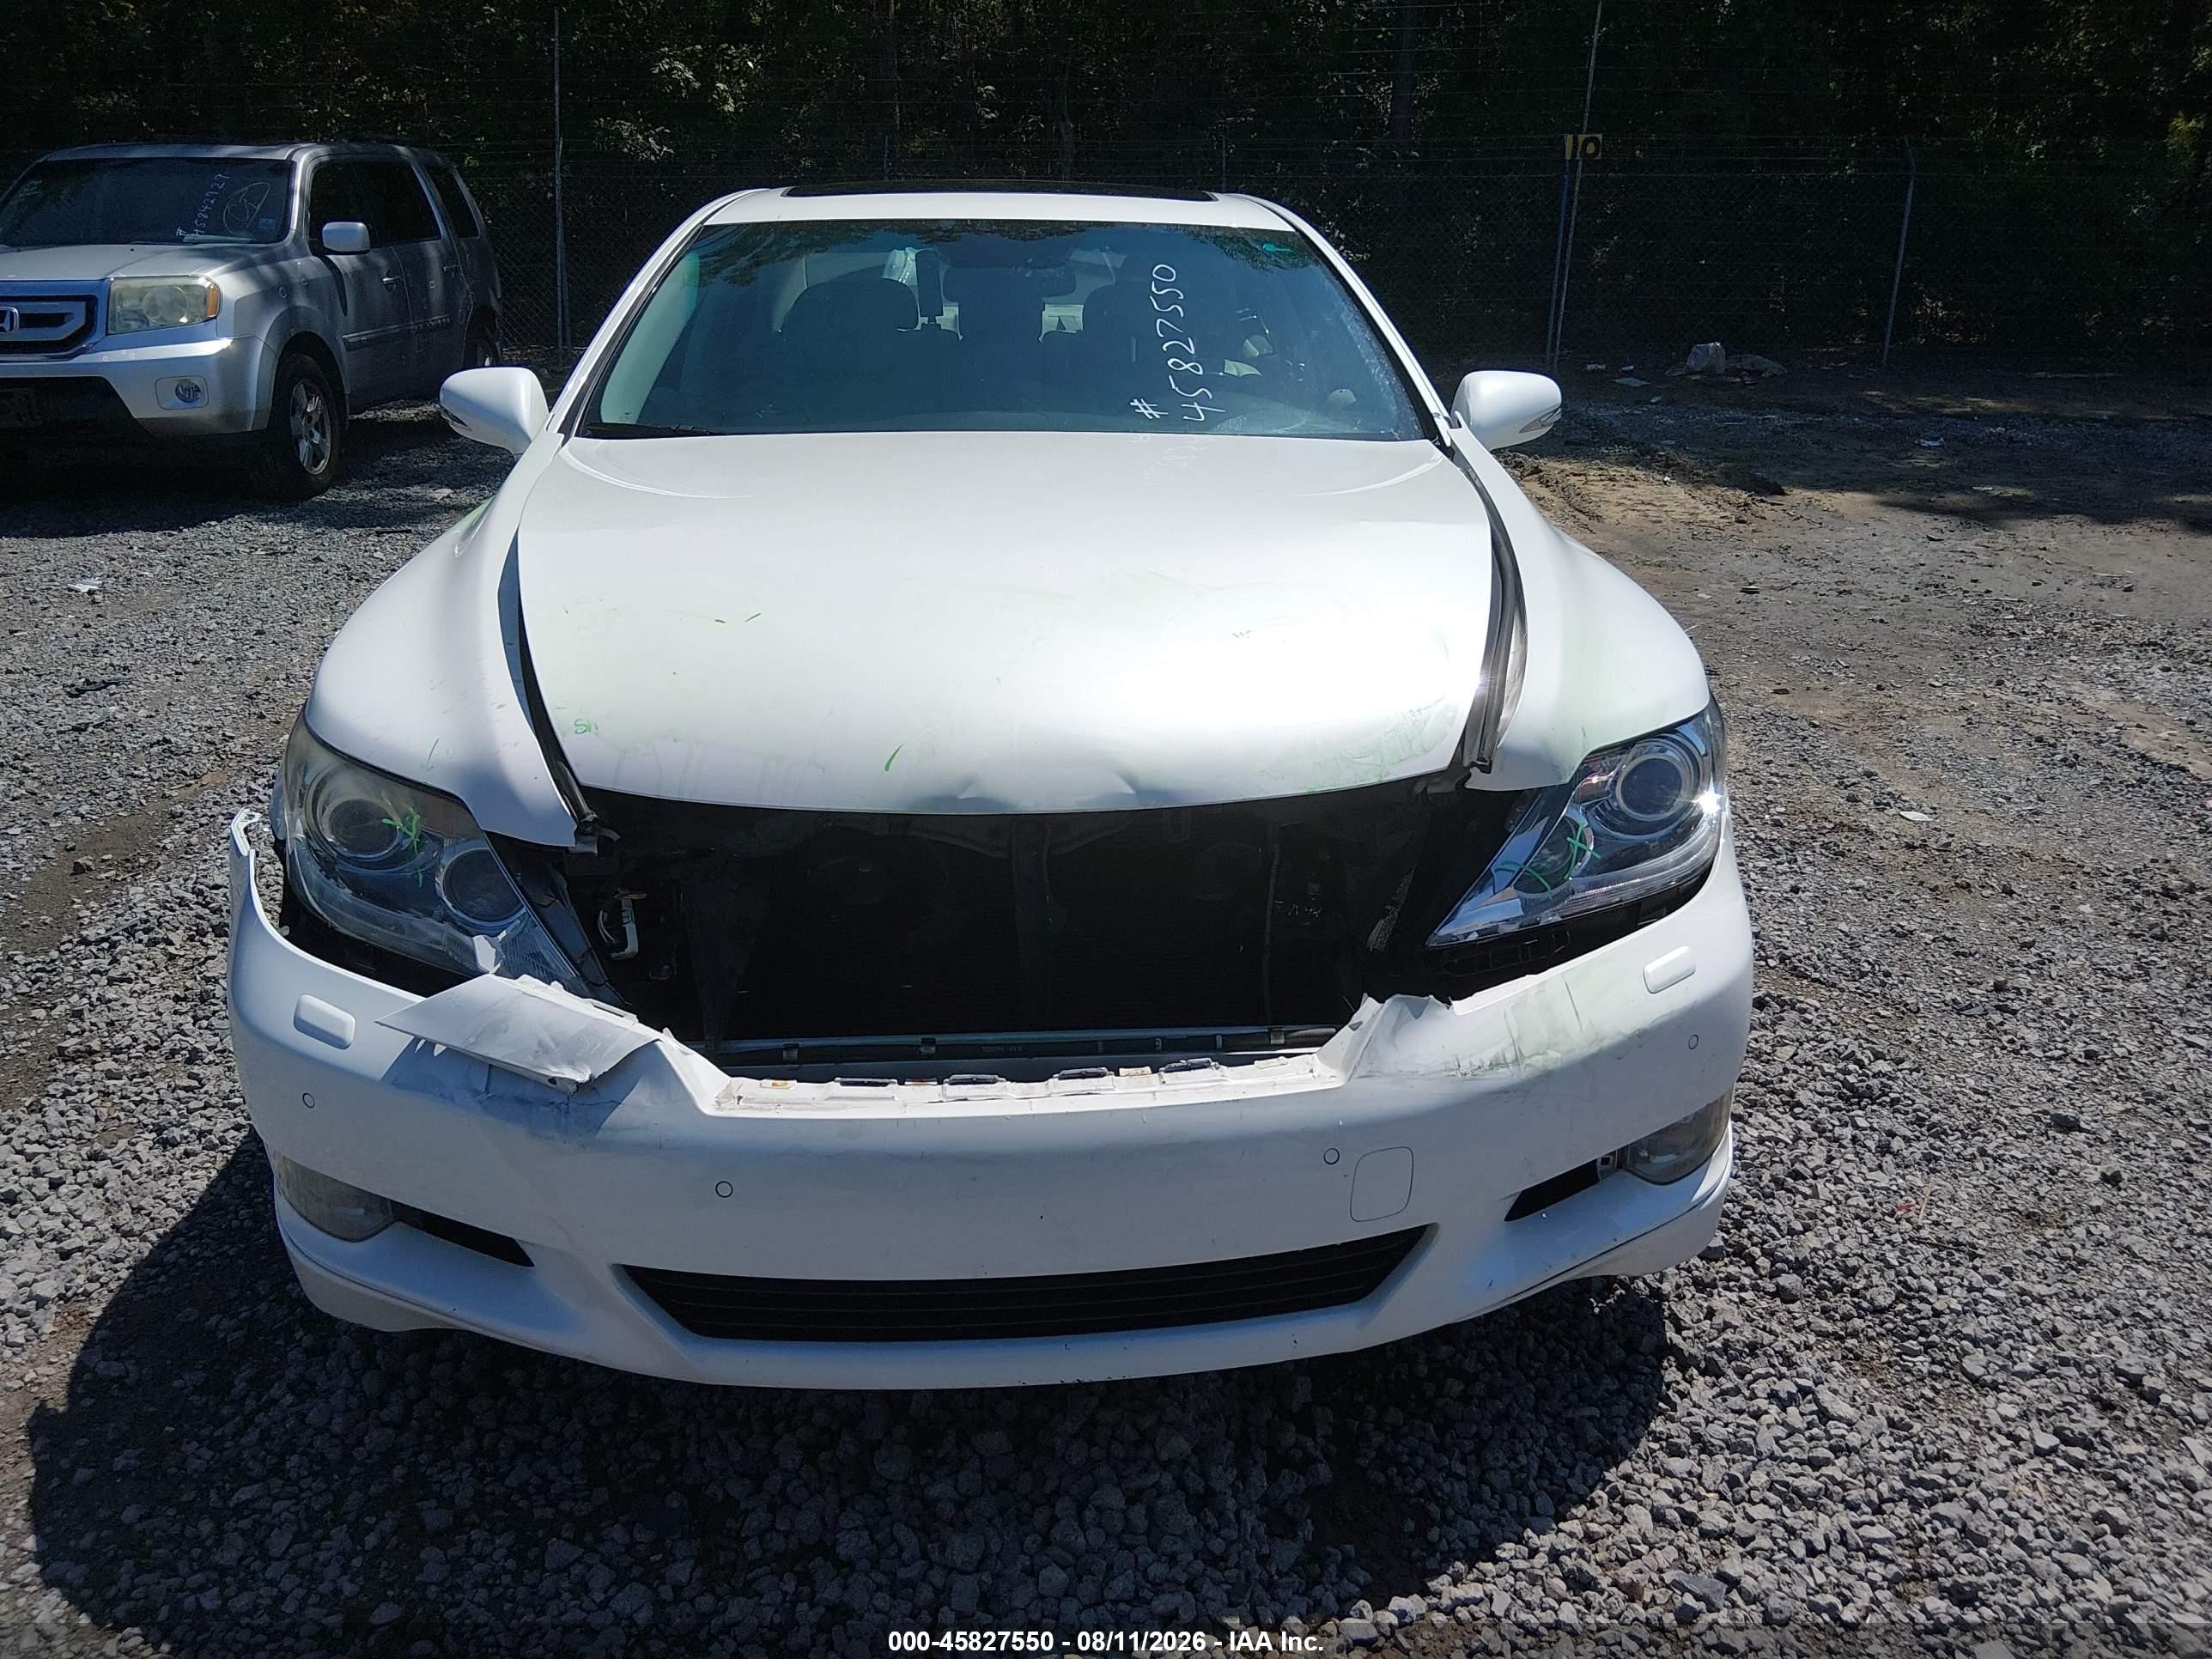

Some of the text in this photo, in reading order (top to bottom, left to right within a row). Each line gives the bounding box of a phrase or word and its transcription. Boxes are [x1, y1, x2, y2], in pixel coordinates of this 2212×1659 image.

[1571, 132, 1601, 160] 10
[1149, 263, 1225, 422] 45827550
[1129, 398, 1168, 421] #
